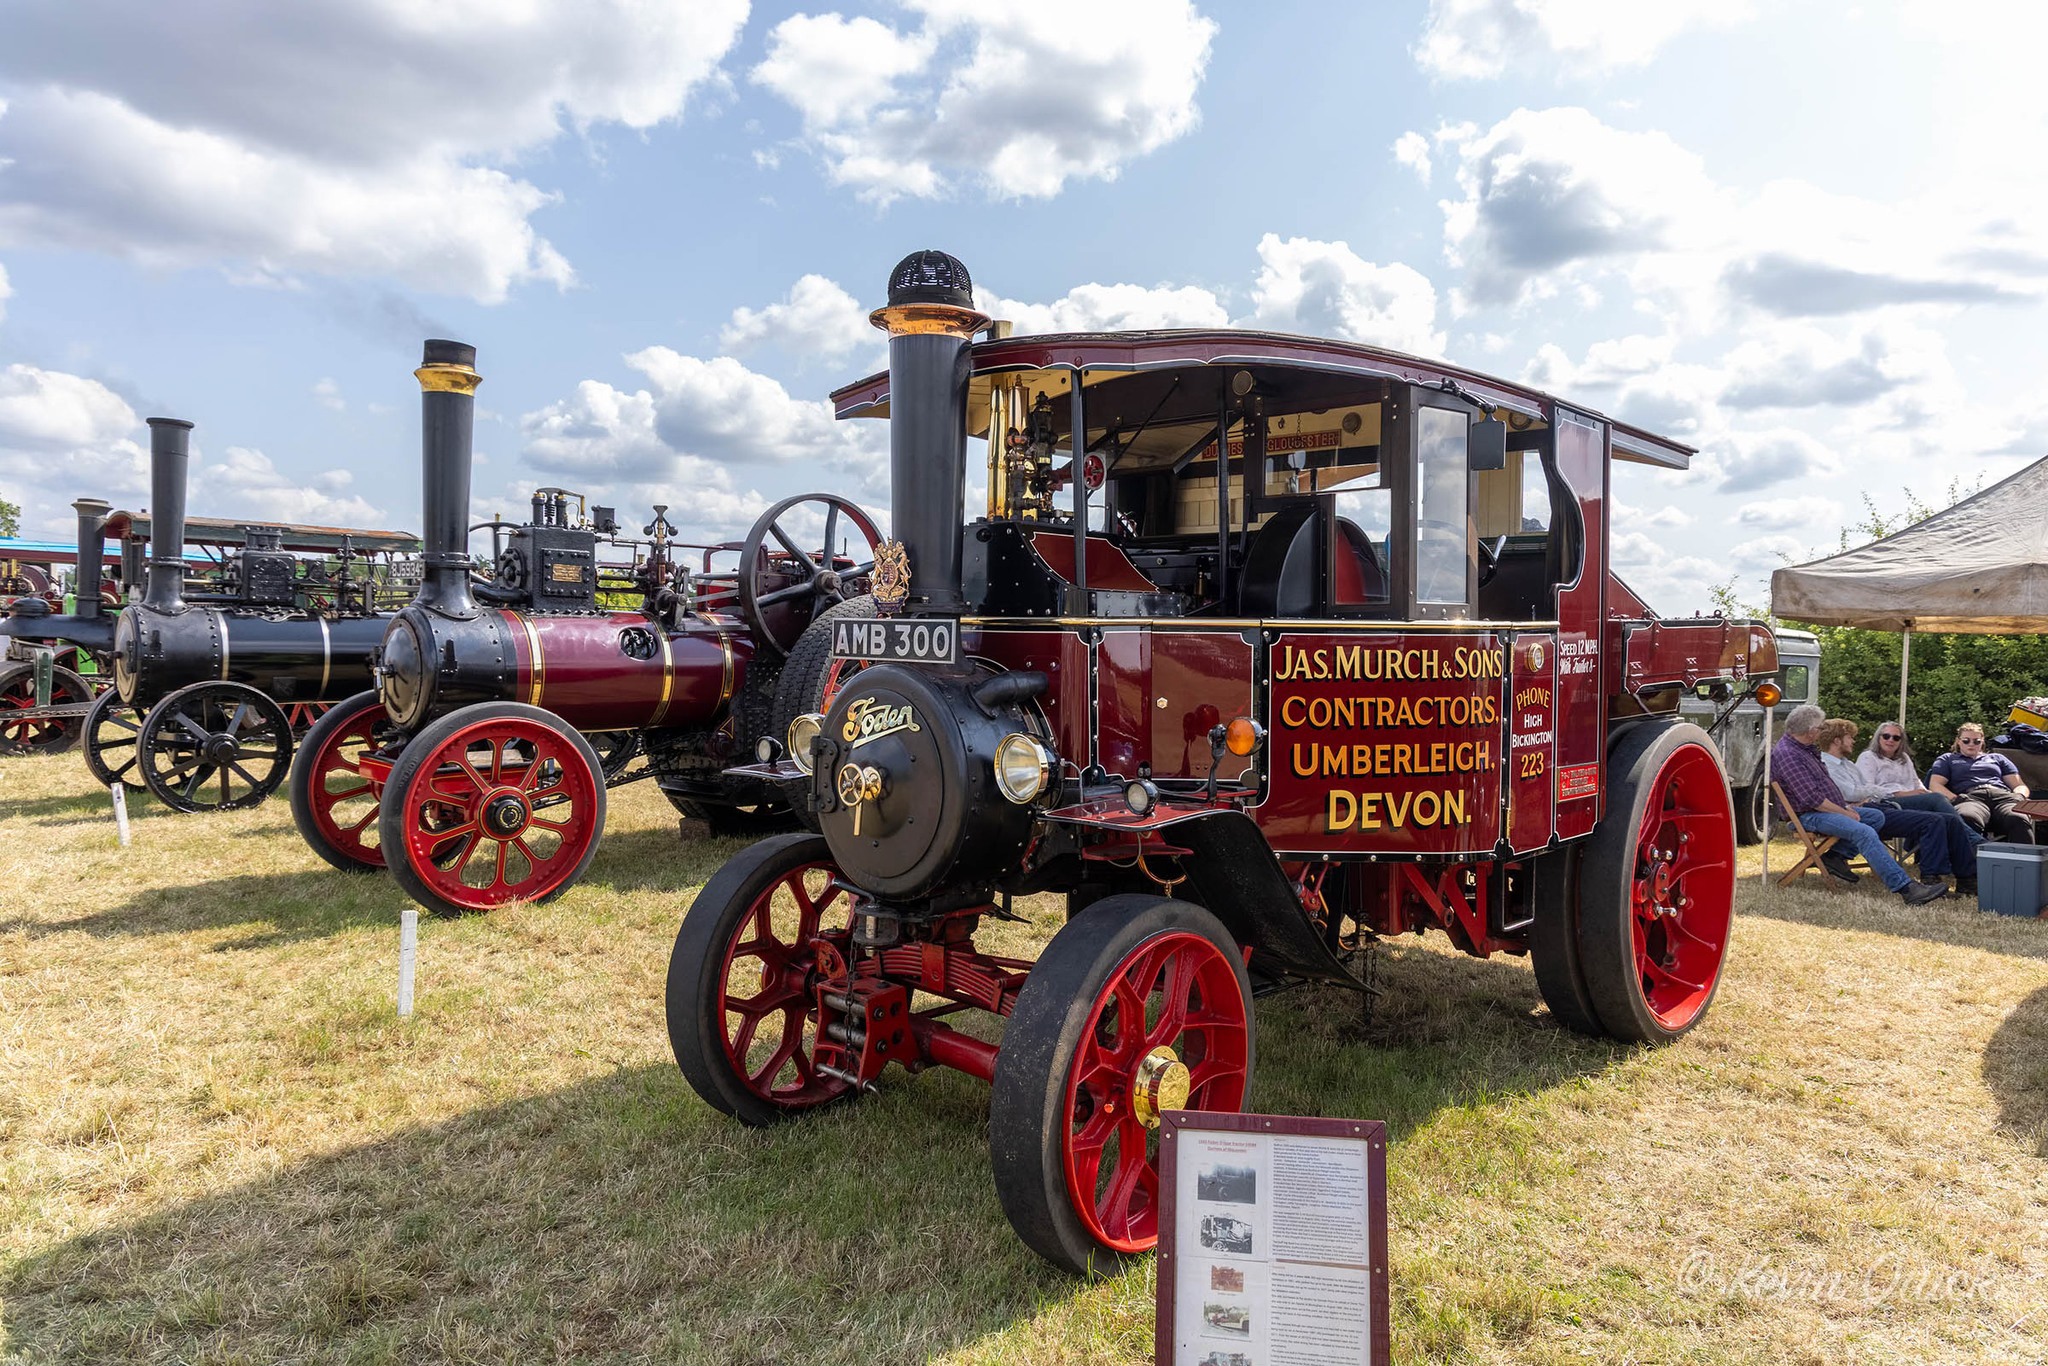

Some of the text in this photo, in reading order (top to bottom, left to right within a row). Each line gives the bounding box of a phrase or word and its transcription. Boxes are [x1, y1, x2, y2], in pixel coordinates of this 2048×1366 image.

[835, 623, 951, 658] AMB 300
[1560, 640, 1578, 656] SPEED
[1275, 646, 1503, 680] JAS. MURCH & SONS
[1282, 696, 1499, 726] CONTRACTORS,
[1516, 687, 1551, 712] PHONE
[842, 697, 921, 749] Foden
[1524, 714, 1543, 728] HIGH
[1512, 731, 1552, 748] BICKINGTON
[1294, 740, 1496, 776] UMBERLEIGH,
[1521, 752, 1544, 778] 223
[1328, 789, 1472, 830] DEVON.
